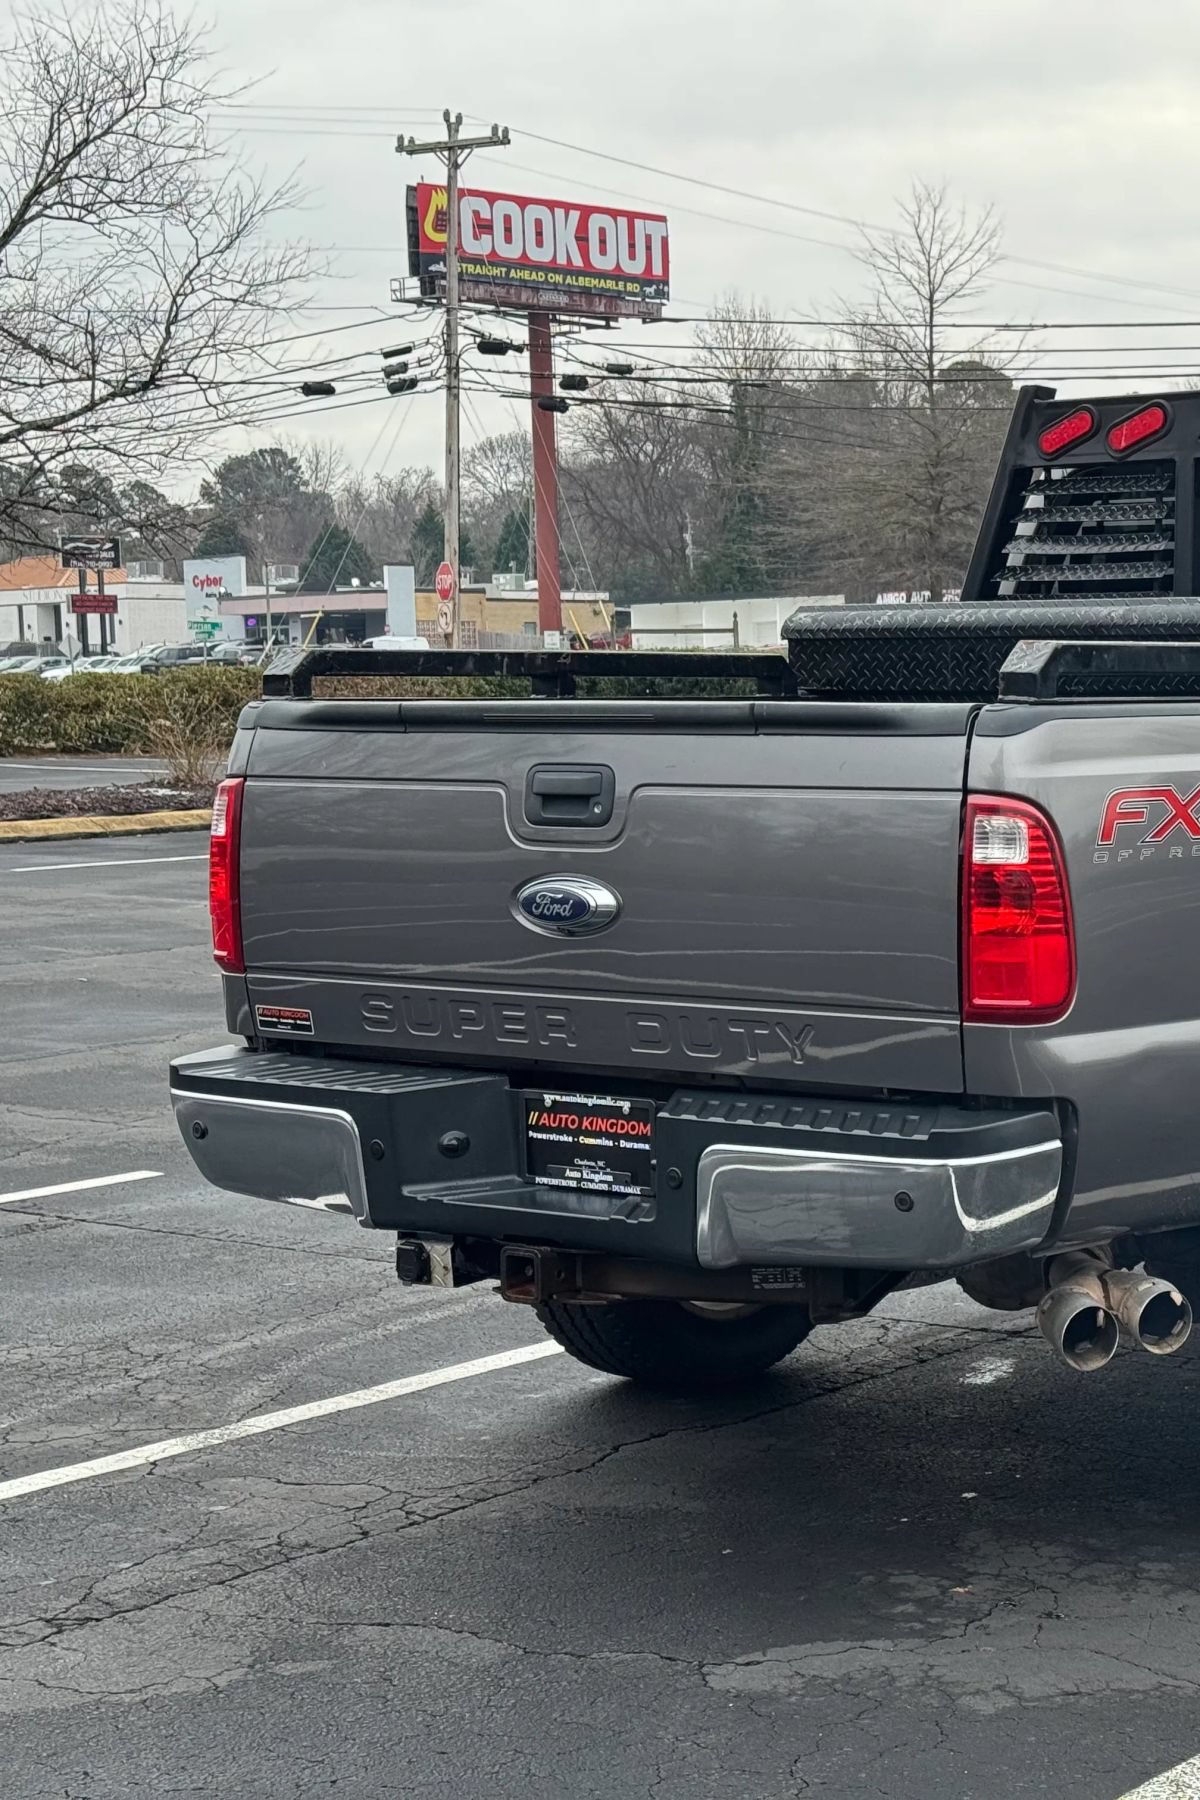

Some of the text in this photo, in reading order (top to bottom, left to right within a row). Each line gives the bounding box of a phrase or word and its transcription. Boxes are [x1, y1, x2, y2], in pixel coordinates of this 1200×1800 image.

[460, 196, 668, 276] COOK OUT
[456, 263, 640, 293] STRAIGHT AHEAD ON ALBEMARLE RD
[438, 574, 452, 590] STOP
[1093, 848, 1155, 864] OFF
[532, 891, 573, 916] Ford
[280, 1010, 309, 1019] KINGDOM
[360, 993, 815, 1065] SUPER DUTY
[543, 1094, 631, 1107] www.autokingdomllc.com
[582, 1117, 651, 1136] KINGDOM
[528, 1131, 573, 1143] Powerstroke
[579, 1136, 614, 1147] Cummins
[565, 1168, 581, 1179] Auto
[582, 1169, 614, 1182] Kingdom
[535, 1176, 577, 1188] POWERSTROKE
[581, 1181, 609, 1191] CUMMINS
[612, 1184, 641, 1195] DURAMAX
